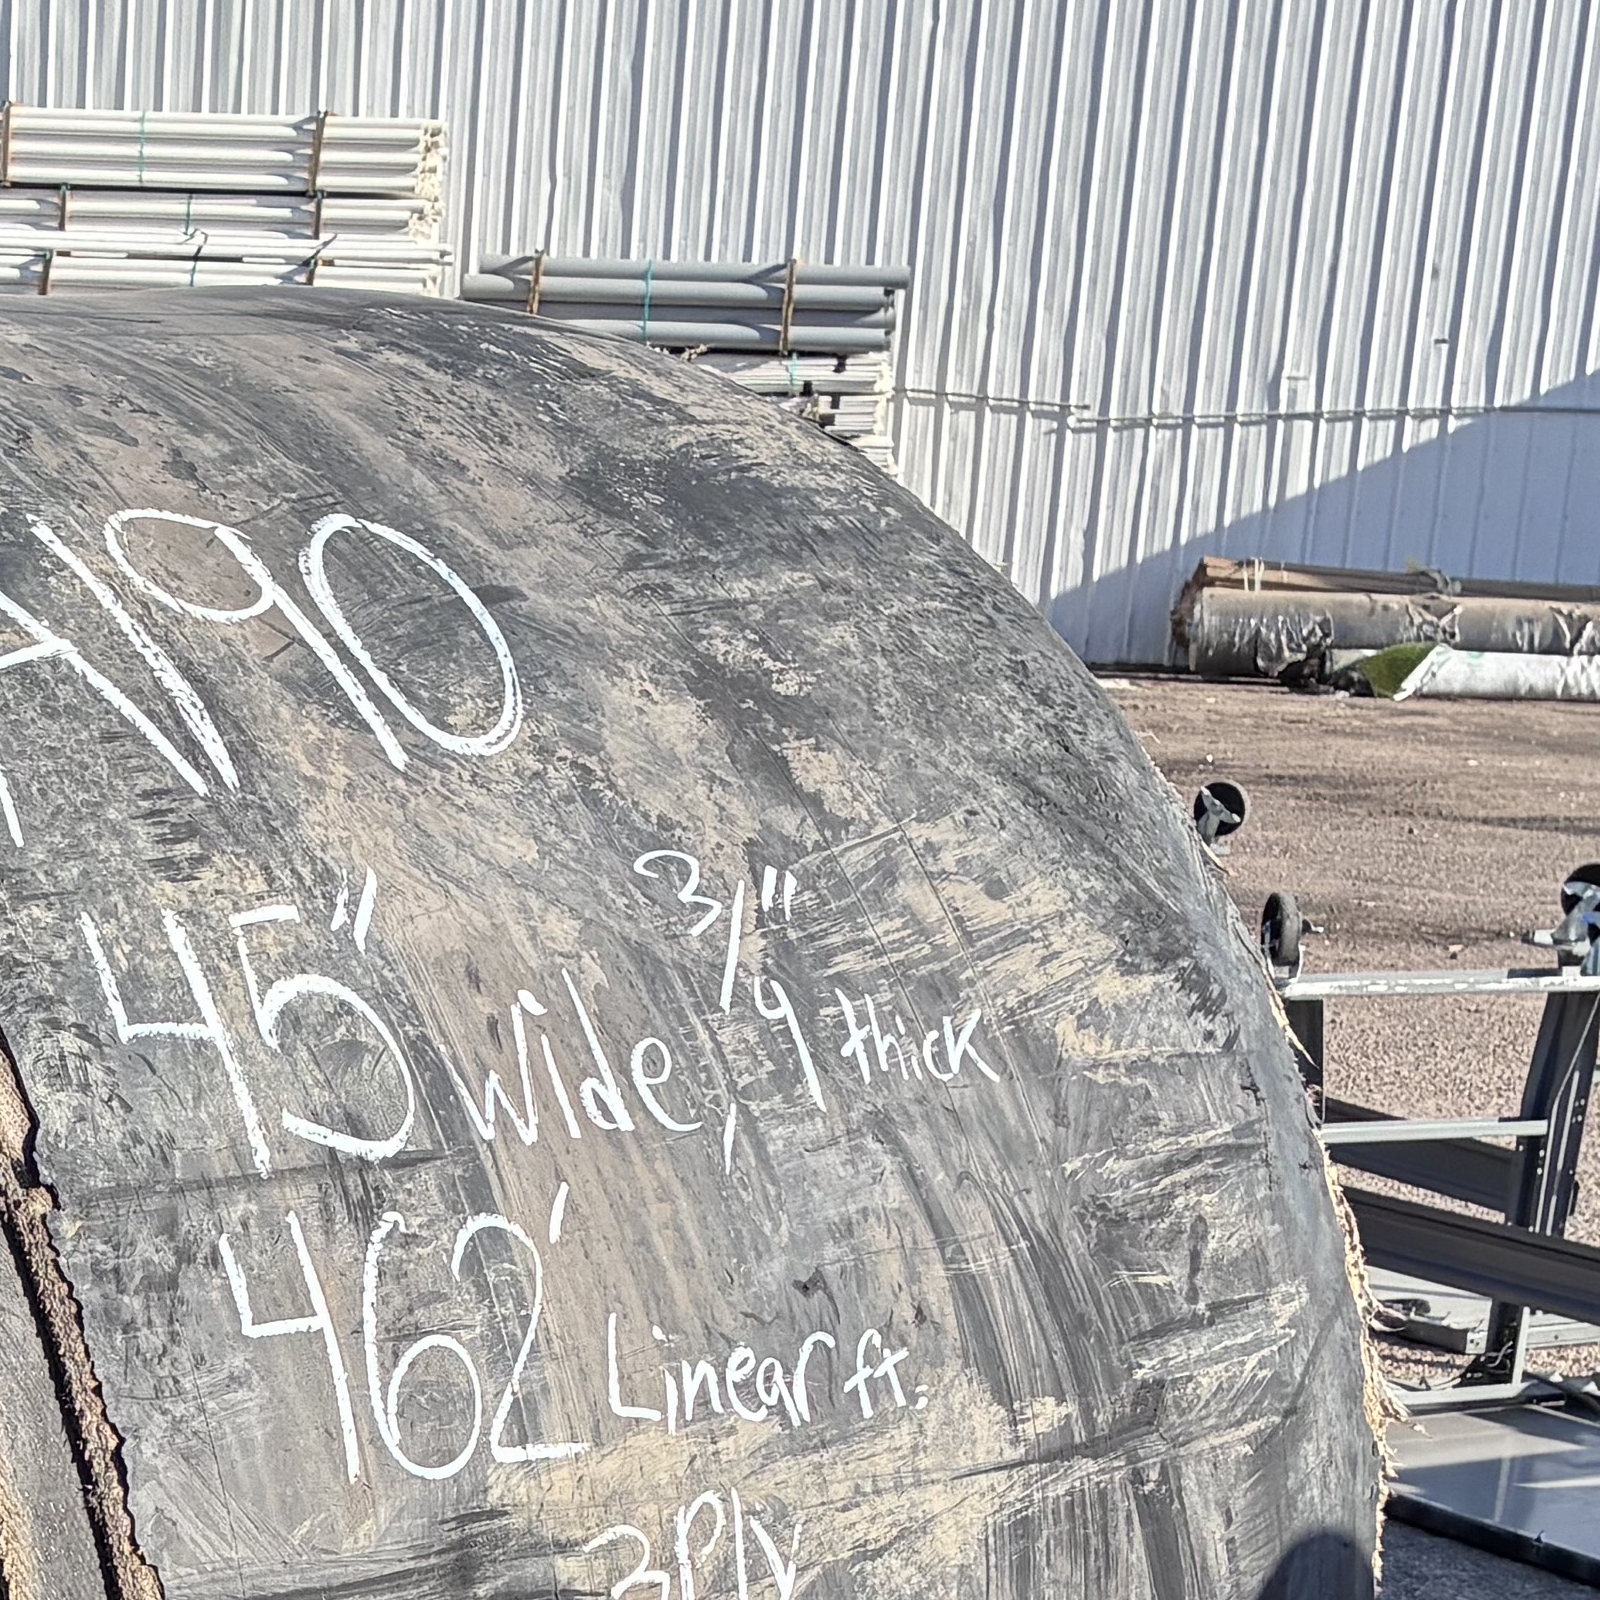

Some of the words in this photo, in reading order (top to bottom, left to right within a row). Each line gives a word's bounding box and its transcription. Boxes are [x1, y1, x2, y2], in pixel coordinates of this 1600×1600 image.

[79, 866, 416, 1181] 45"
[835, 987, 1001, 1085] thick
[606, 1312, 836, 1436] Linear
